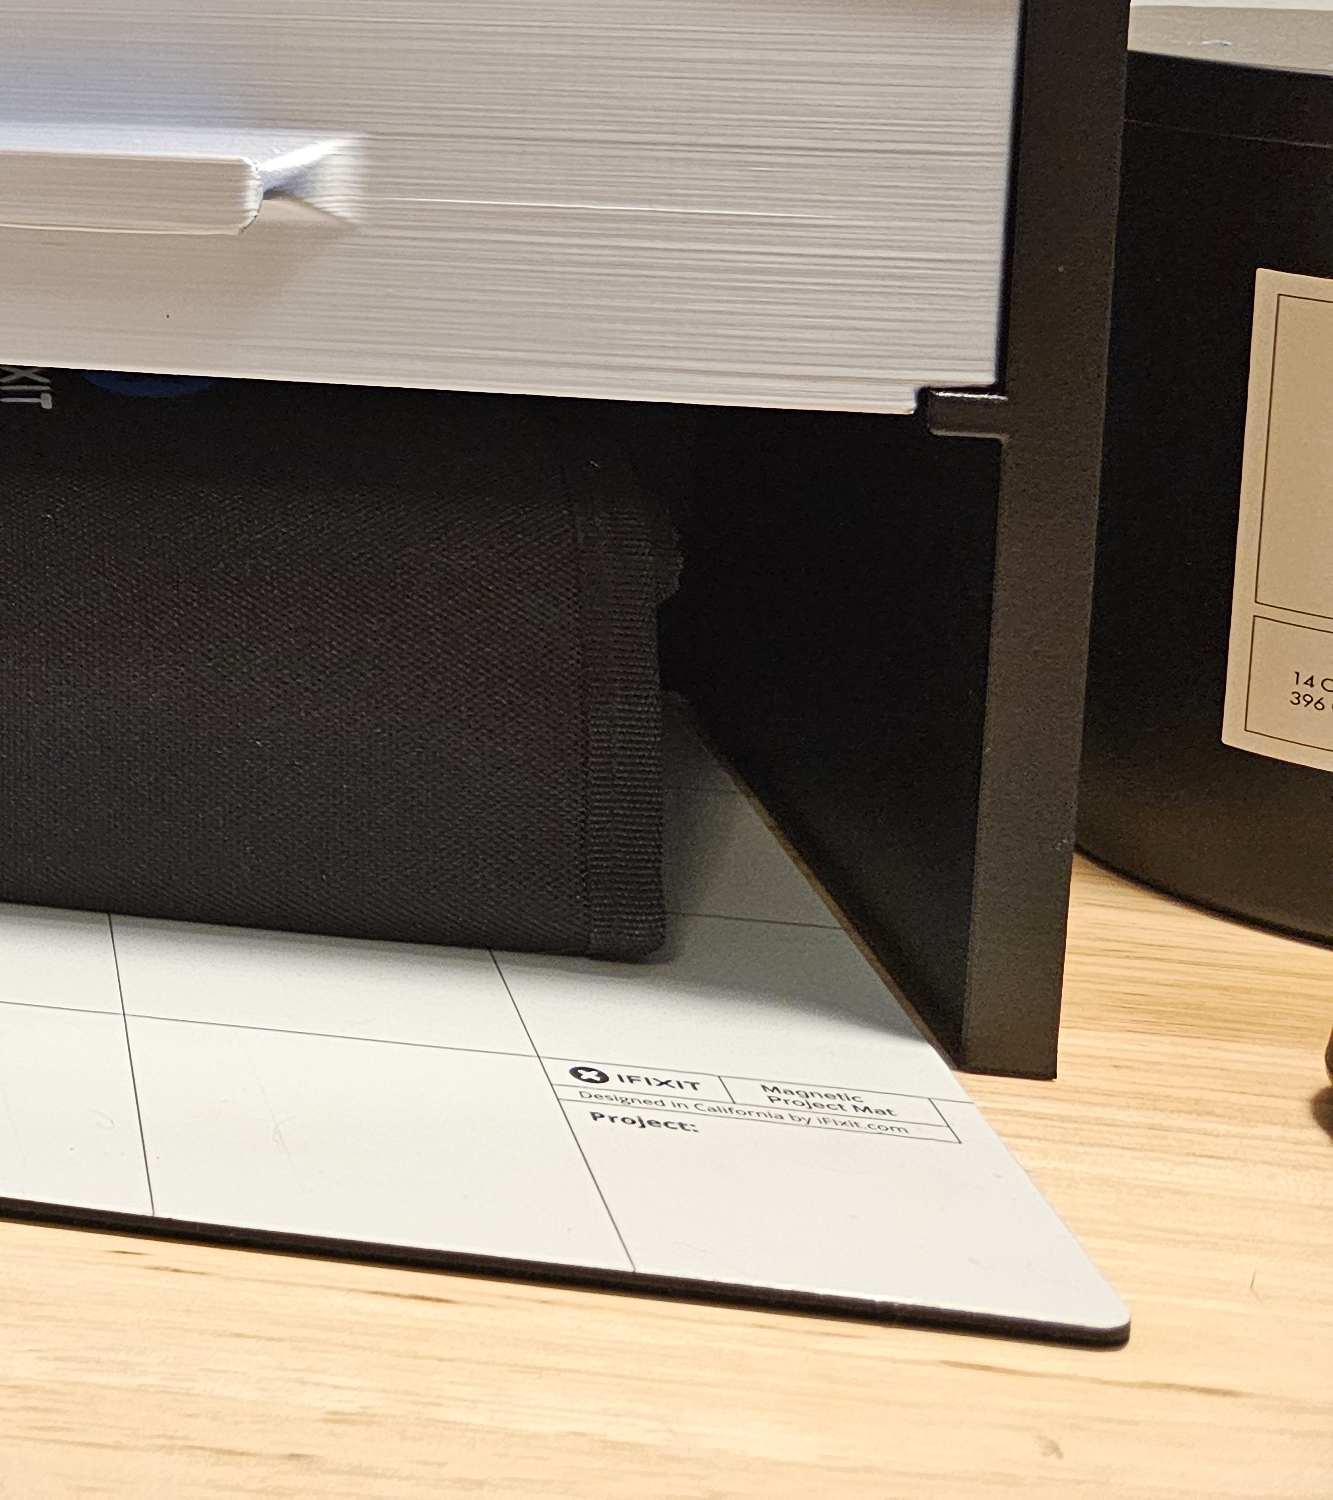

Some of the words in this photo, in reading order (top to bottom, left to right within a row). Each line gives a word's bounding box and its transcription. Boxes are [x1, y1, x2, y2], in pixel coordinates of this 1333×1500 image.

[1294, 671, 1315, 688] 14
[1289, 691, 1325, 711] 396
[617, 1073, 701, 1091] IFIXIT
[760, 1084, 864, 1103] Magnetic
[579, 1090, 666, 1108] Designed
[671, 1100, 689, 1110] in
[693, 1102, 784, 1120] California
[788, 1112, 812, 1125] by
[816, 1116, 909, 1134] iFixit.com
[766, 1094, 847, 1112] Project
[852, 1104, 897, 1117] Mat
[589, 1111, 700, 1133] Project:
